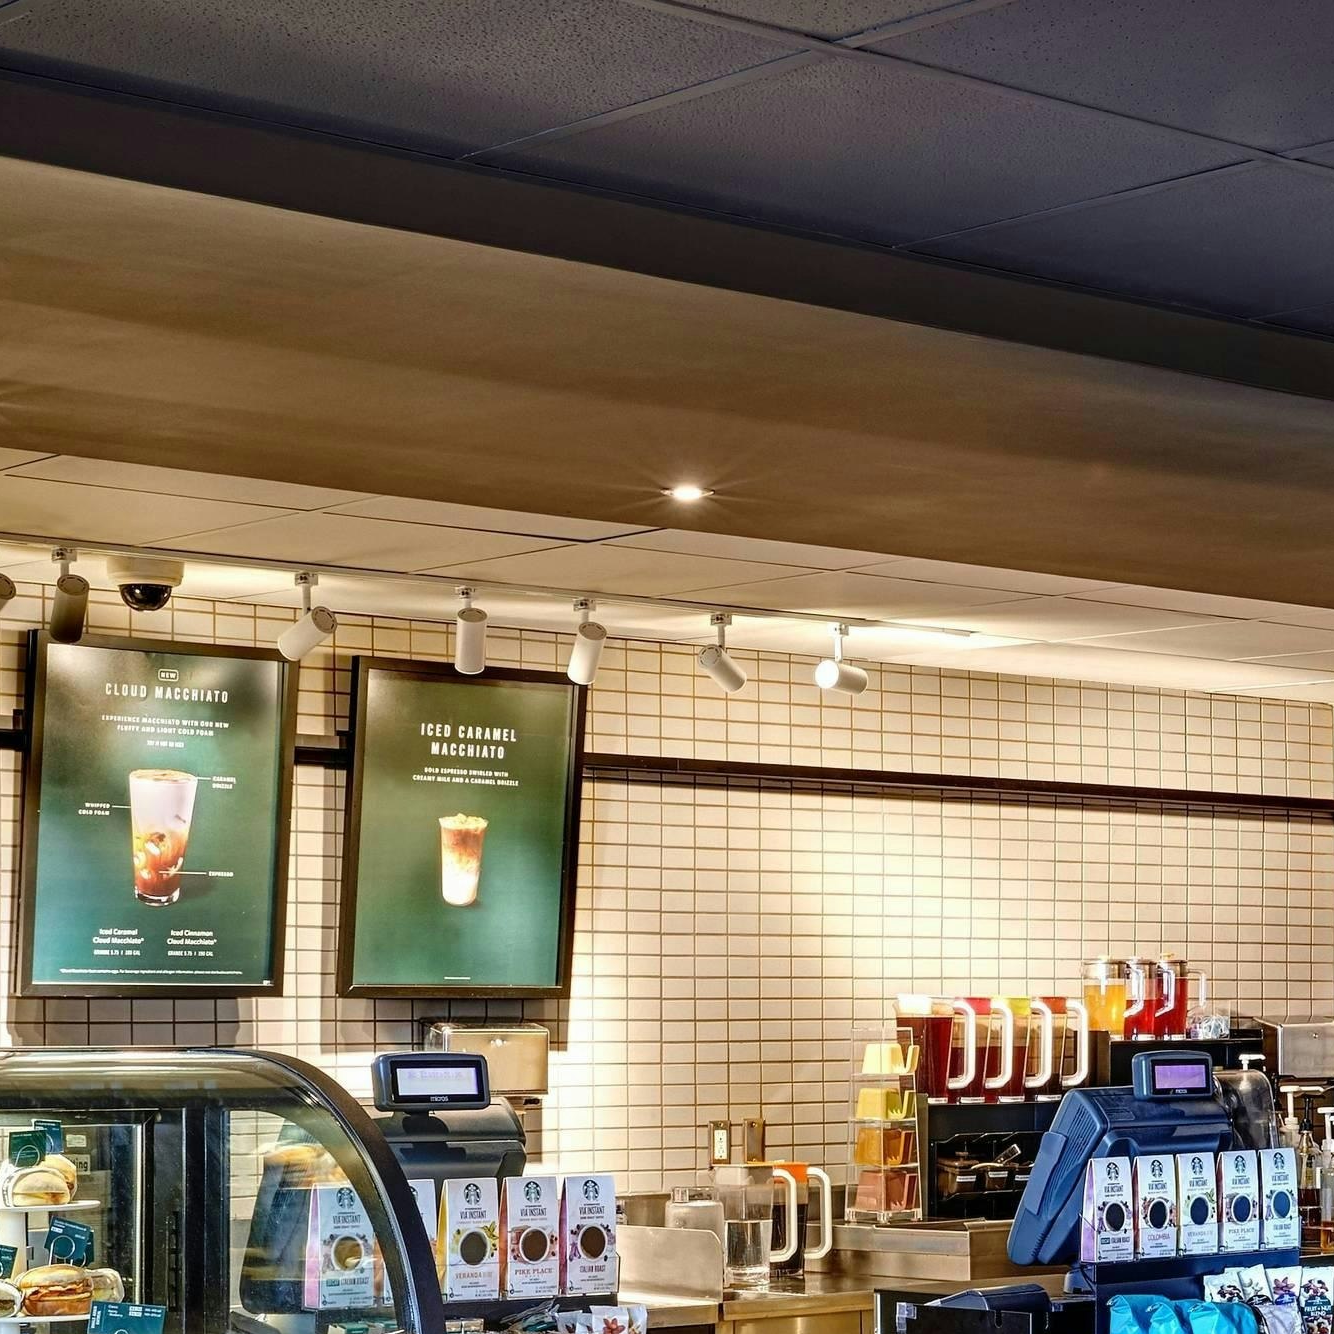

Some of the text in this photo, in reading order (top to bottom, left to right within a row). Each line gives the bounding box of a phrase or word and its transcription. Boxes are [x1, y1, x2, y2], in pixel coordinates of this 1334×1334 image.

[105, 683, 228, 703] CLOUD MACCHIATO
[421, 723, 516, 742] ICED CARAMEL
[431, 742, 504, 759] MACCHIATO
